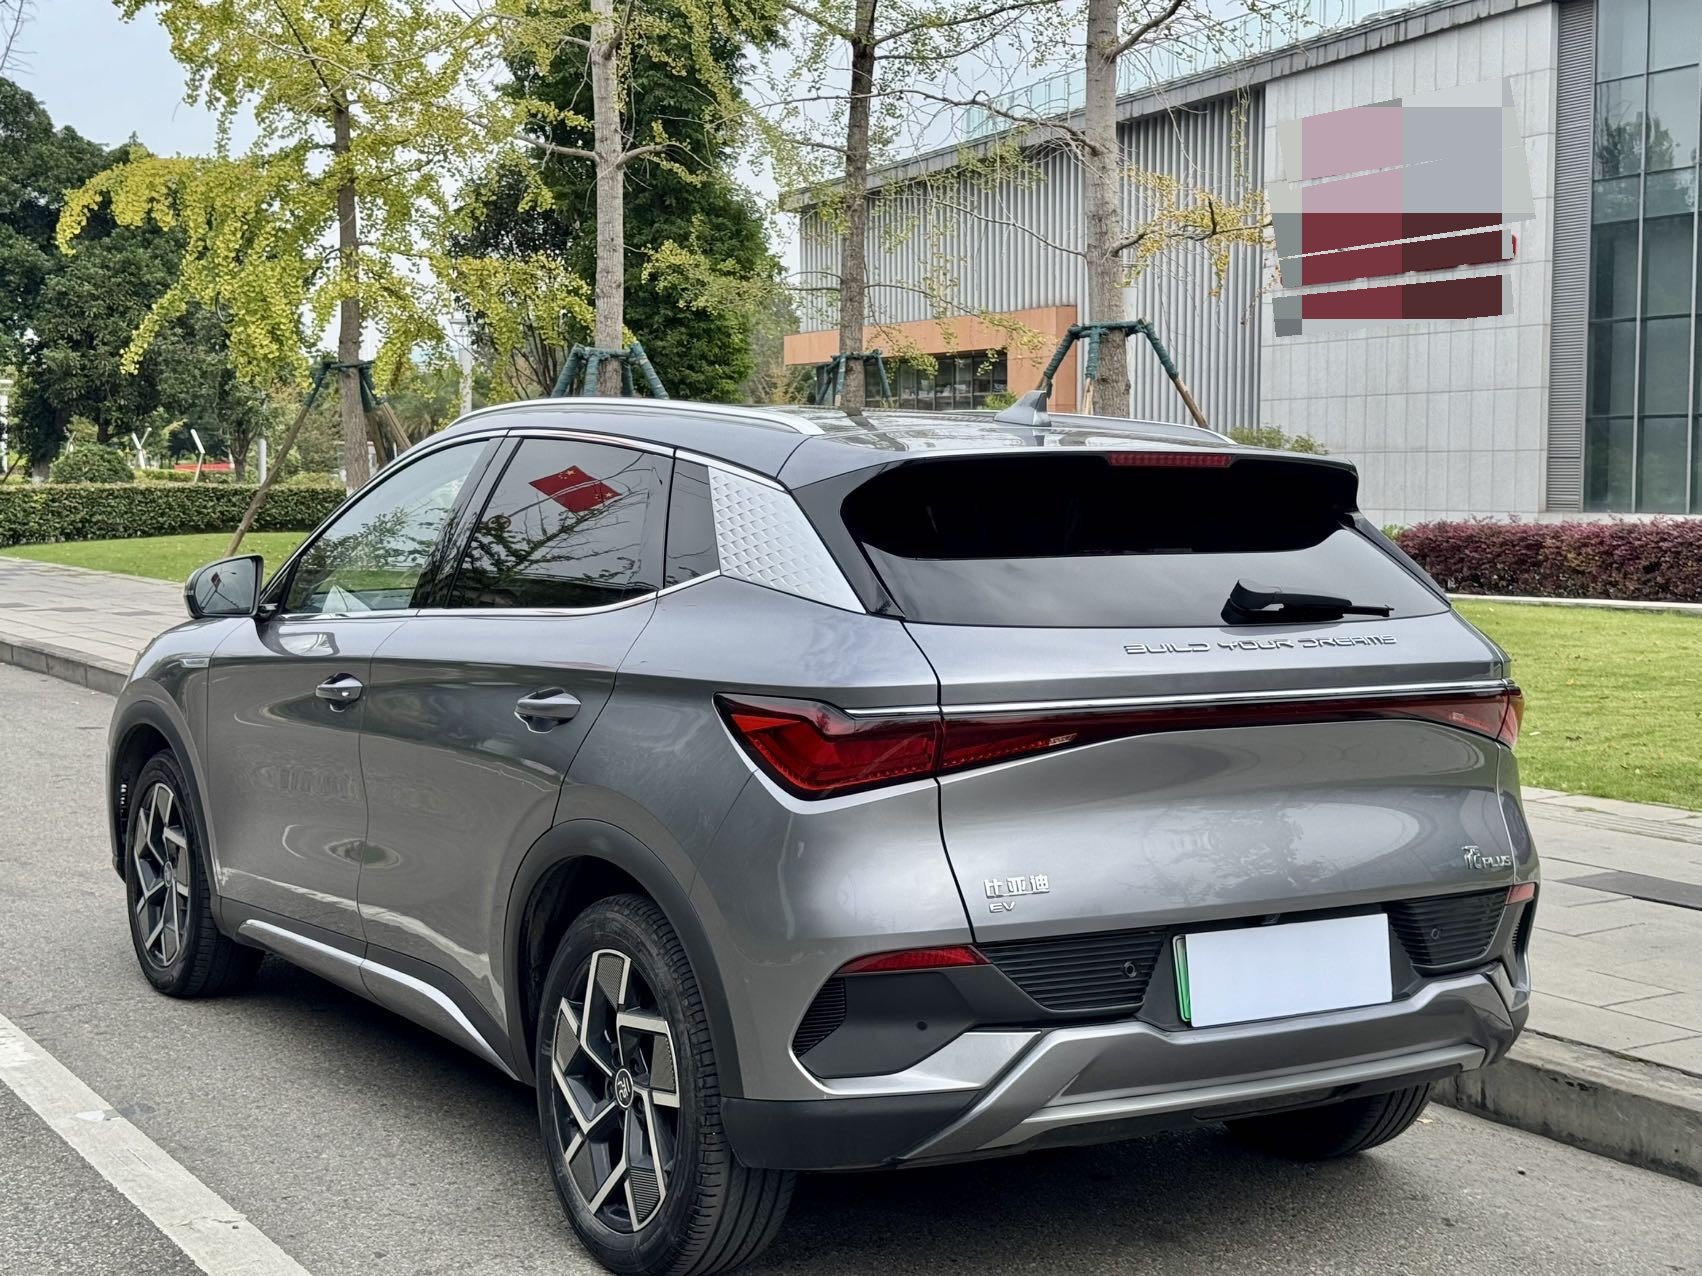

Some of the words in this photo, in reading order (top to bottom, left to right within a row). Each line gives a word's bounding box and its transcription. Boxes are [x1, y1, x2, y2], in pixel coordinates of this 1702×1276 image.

[1123, 643, 1211, 655] BUILD
[1217, 639, 1294, 651] YOUR
[1298, 634, 1397, 649] DREAMS
[984, 873, 1050, 898] 比亚迪
[989, 901, 1016, 913] EV
